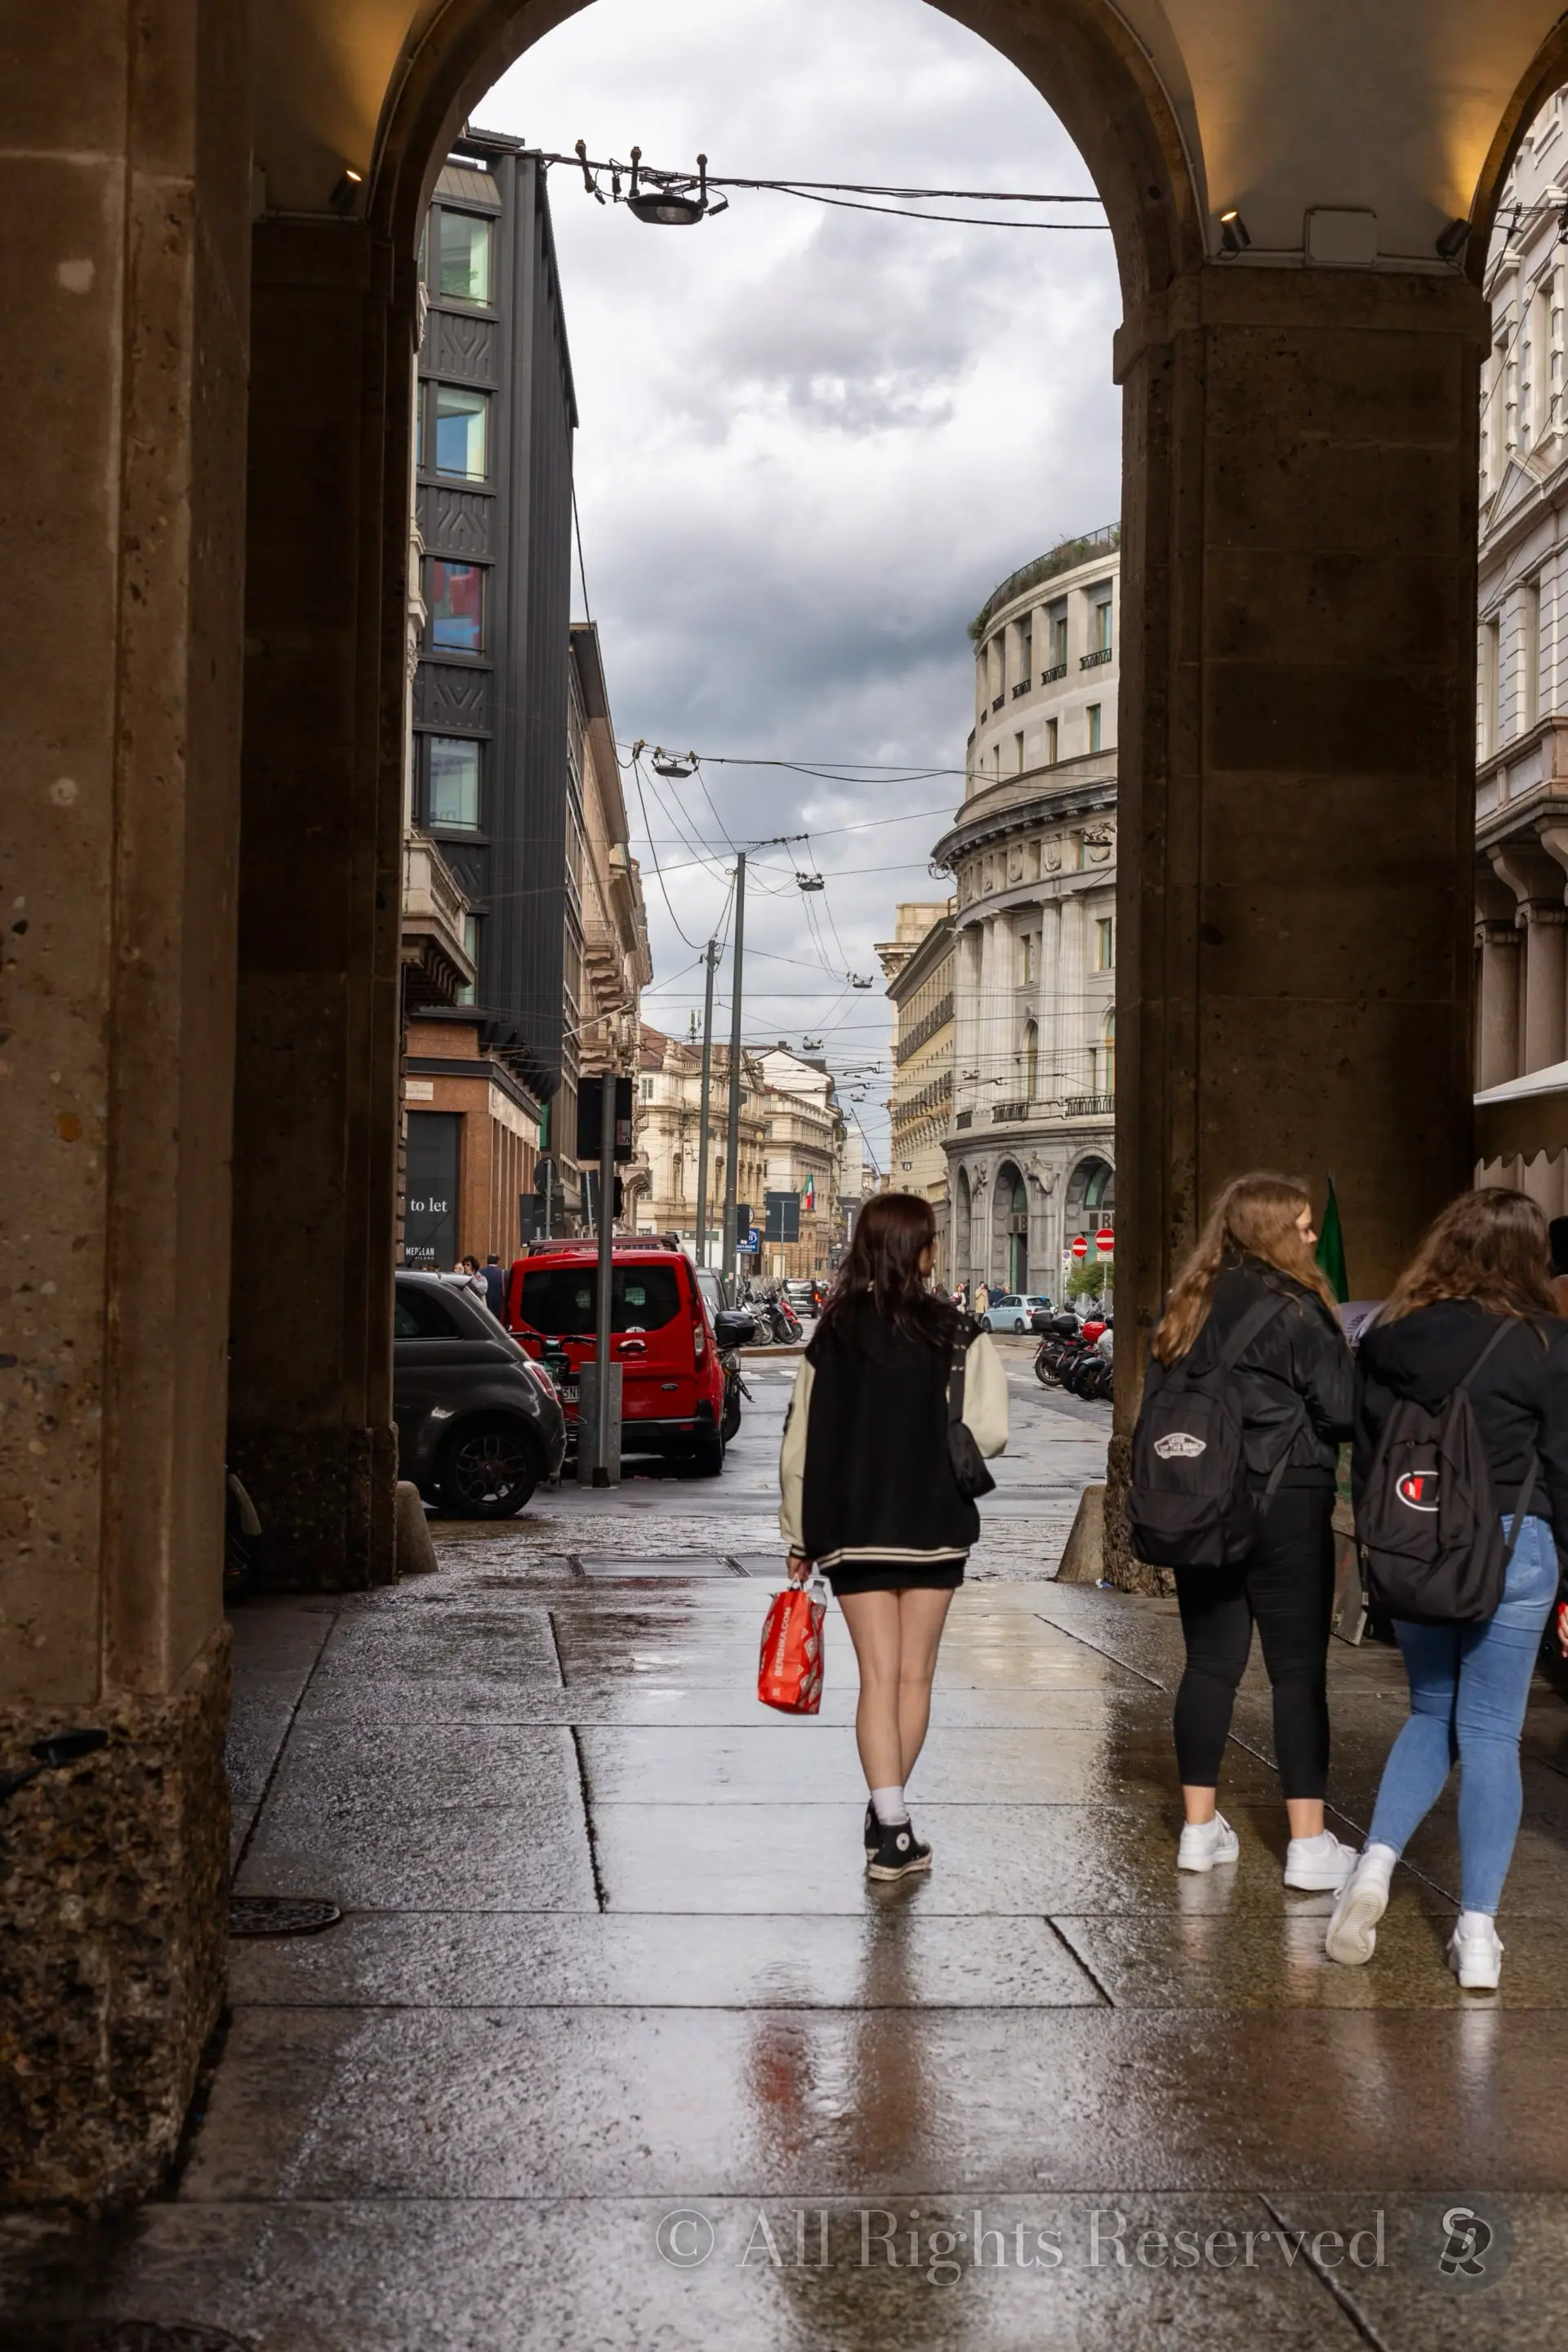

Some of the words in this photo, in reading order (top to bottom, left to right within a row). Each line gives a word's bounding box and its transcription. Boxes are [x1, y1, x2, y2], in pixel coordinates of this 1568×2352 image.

[410, 1198, 425, 1211] to
[428, 1197, 447, 1212] let
[774, 1606, 792, 1677] BERSHKA.COM
